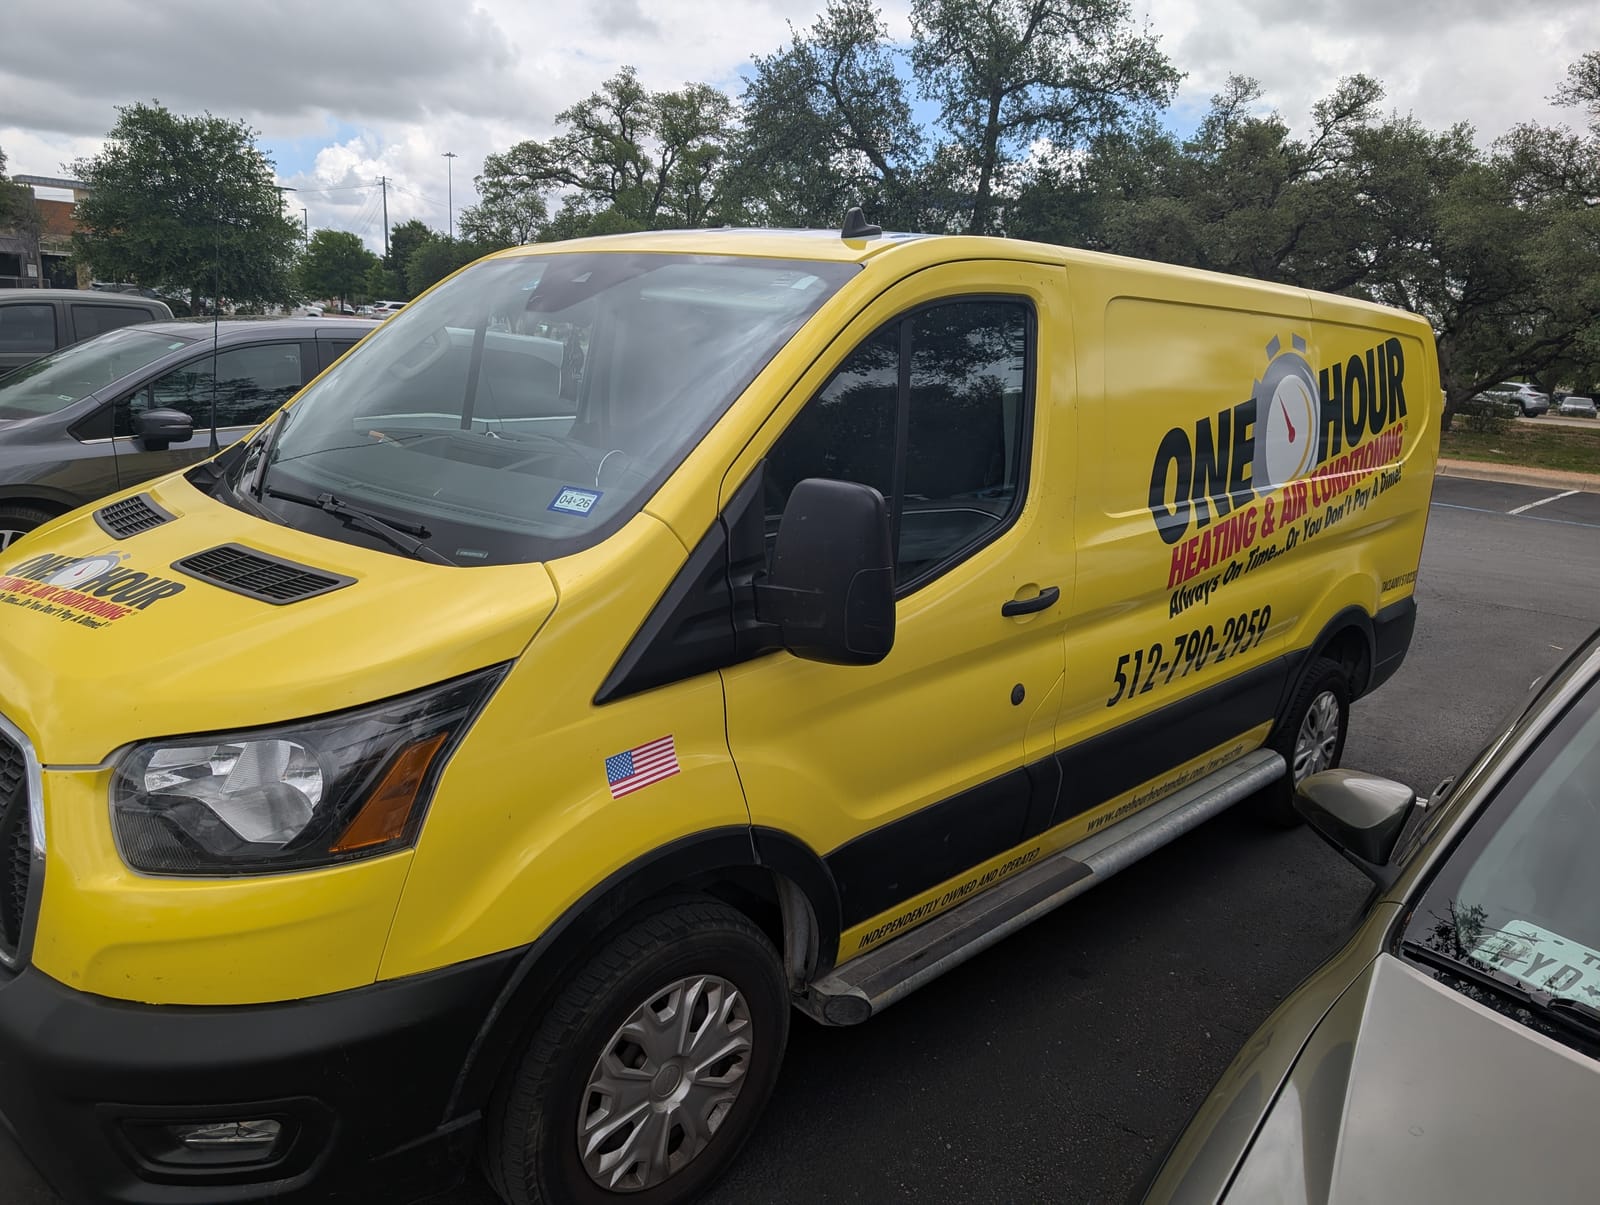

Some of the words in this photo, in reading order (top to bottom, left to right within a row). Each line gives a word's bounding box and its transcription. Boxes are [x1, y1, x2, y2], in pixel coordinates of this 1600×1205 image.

[1149, 398, 1257, 545] ONE
[1317, 337, 1407, 464] HOUR
[1167, 507, 1257, 591] HEATING
[1261, 497, 1275, 539] &
[1279, 480, 1309, 530] AIR
[1311, 422, 1403, 508] CONDITIONING
[1169, 575, 1222, 620] Always
[1223, 560, 1243, 586] On
[1303, 516, 1322, 542] You
[1324, 494, 1352, 528] Don't
[1353, 488, 1371, 511] Pay
[1371, 477, 1378, 500] A
[5, 553, 86, 581] ONE
[72, 566, 186, 610] HOUR
[47, 590, 133, 620] CONDITIONING
[1106, 604, 1271, 707] 512-790-2959
[858, 898, 941, 949] INDEPENDENTLY
[941, 879, 977, 906] OWNED
[977, 868, 999, 888] AND
[999, 847, 1041, 878] OPERATED
